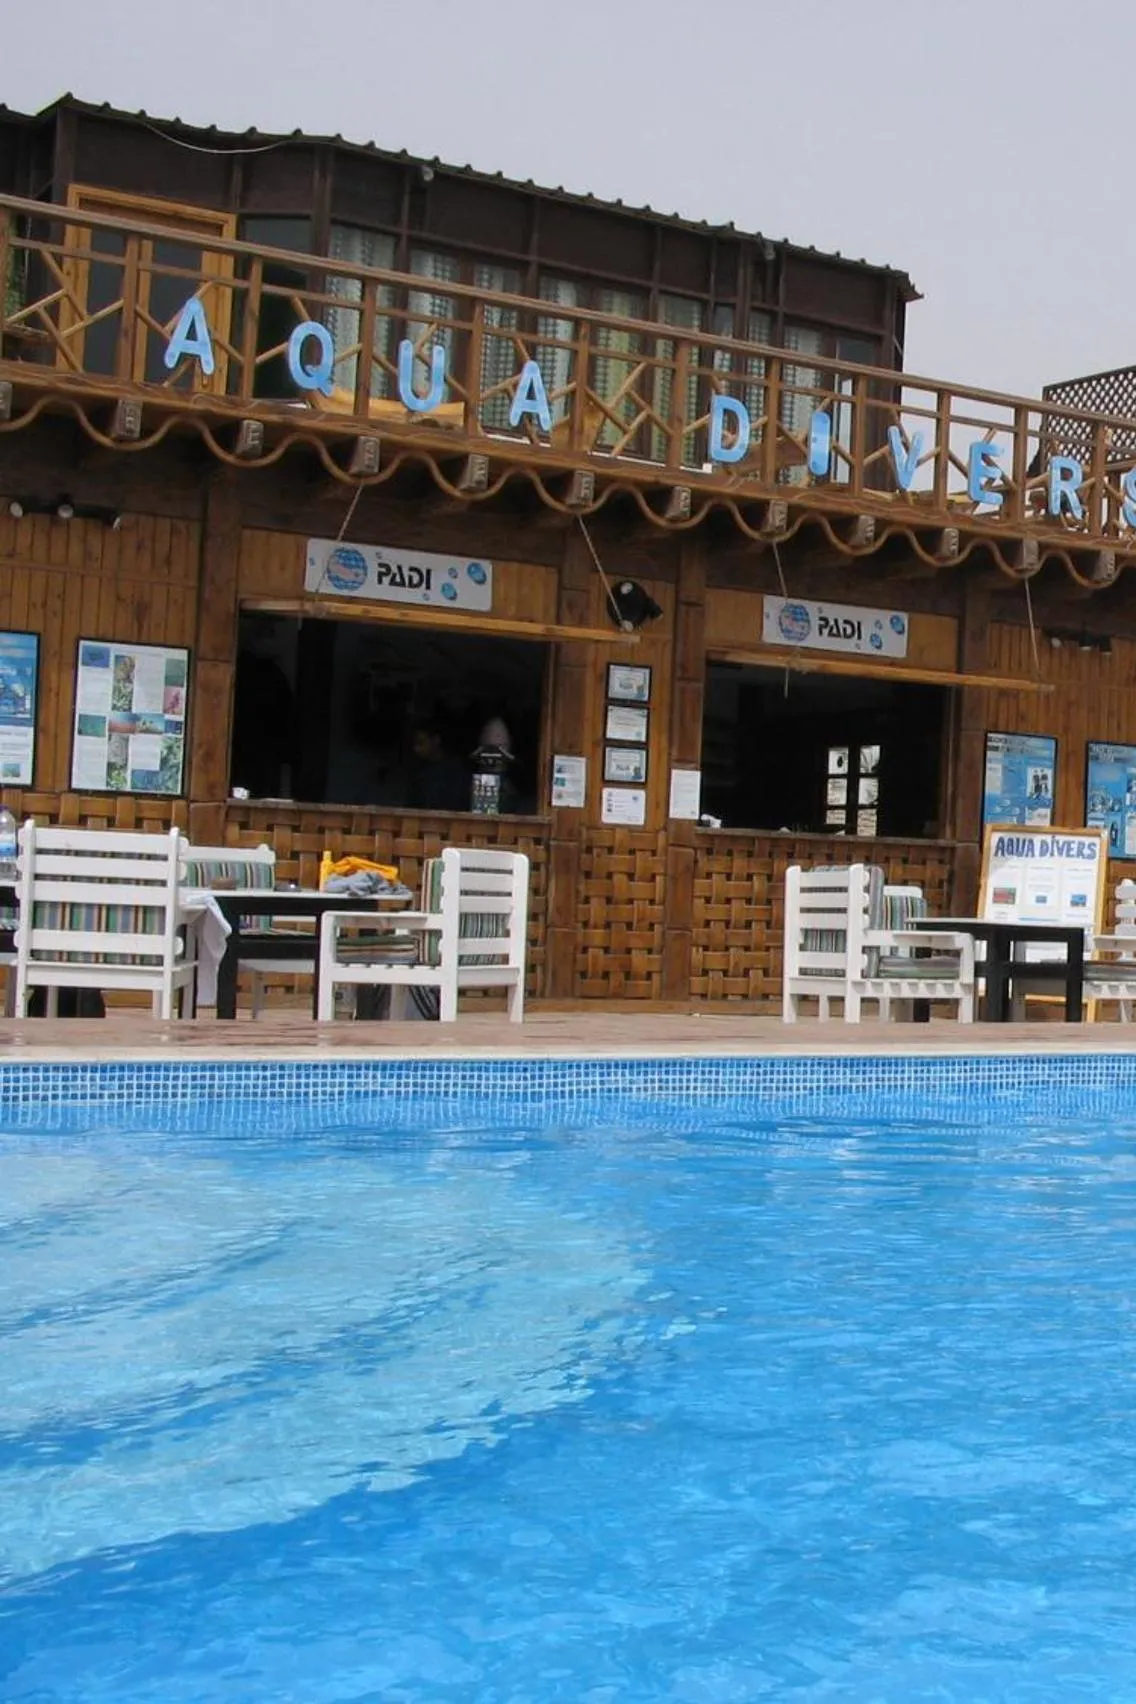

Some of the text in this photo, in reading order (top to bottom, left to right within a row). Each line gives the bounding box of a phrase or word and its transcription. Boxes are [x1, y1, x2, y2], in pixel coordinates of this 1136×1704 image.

[163, 296, 552, 432] AQUA
[376, 562, 432, 591] PADI
[817, 616, 862, 641] PADI
[994, 836, 1035, 858] AQUA
